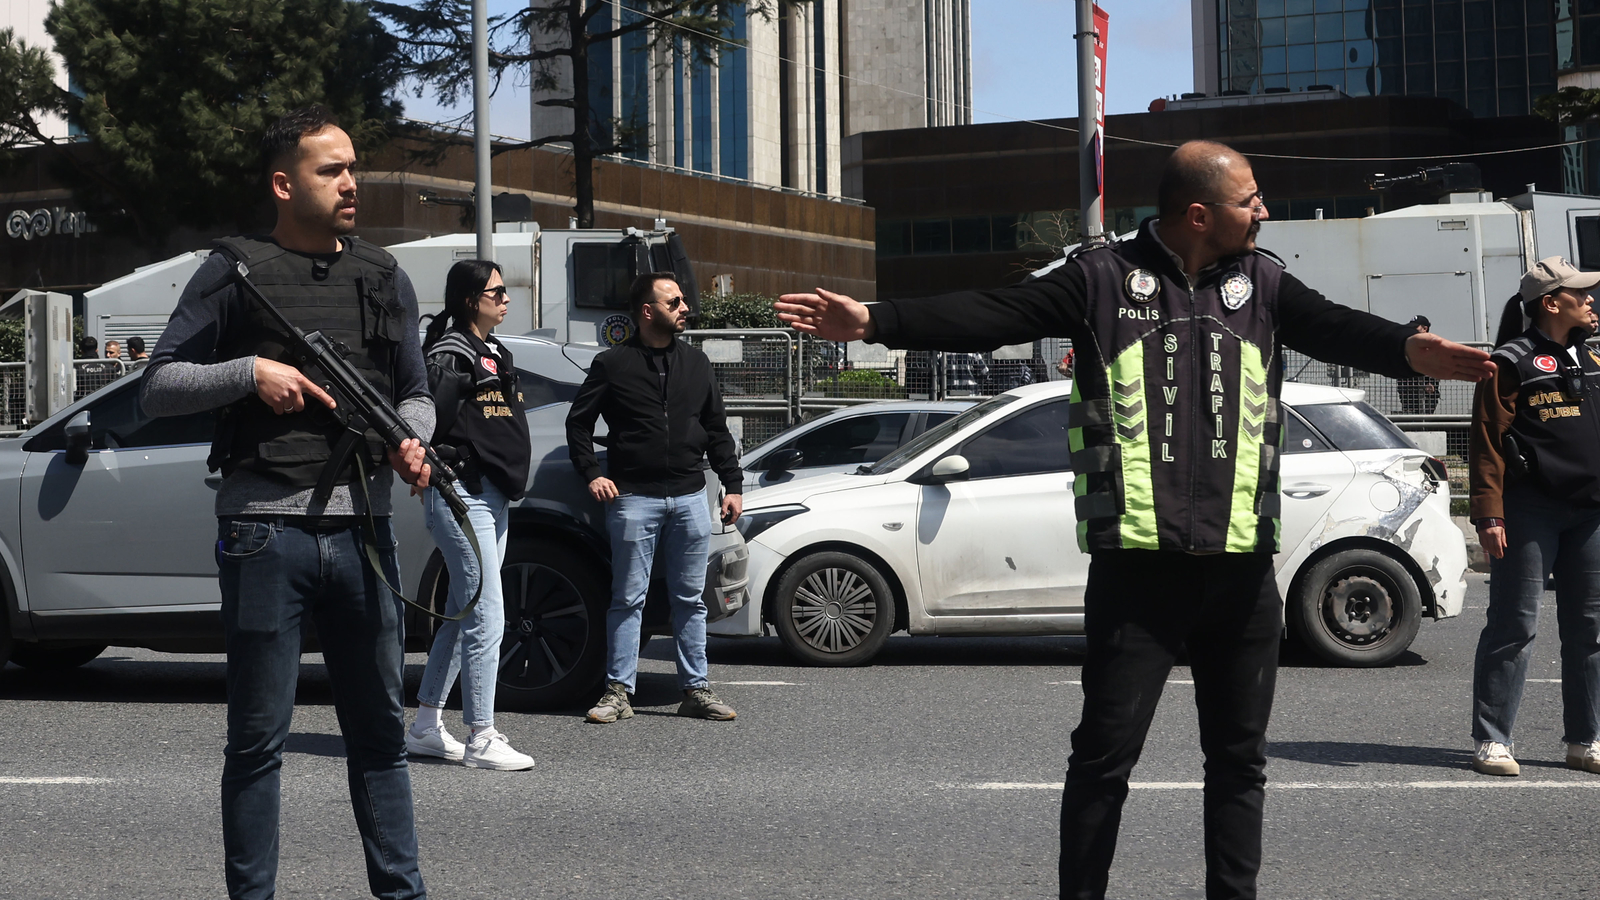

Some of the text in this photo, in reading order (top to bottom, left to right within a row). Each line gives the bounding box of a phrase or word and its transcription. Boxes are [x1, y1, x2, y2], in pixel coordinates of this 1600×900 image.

[1118, 306, 1160, 320] POLİS
[1210, 332, 1227, 458] TRAFİK
[1539, 406, 1581, 422] ŞUBE
